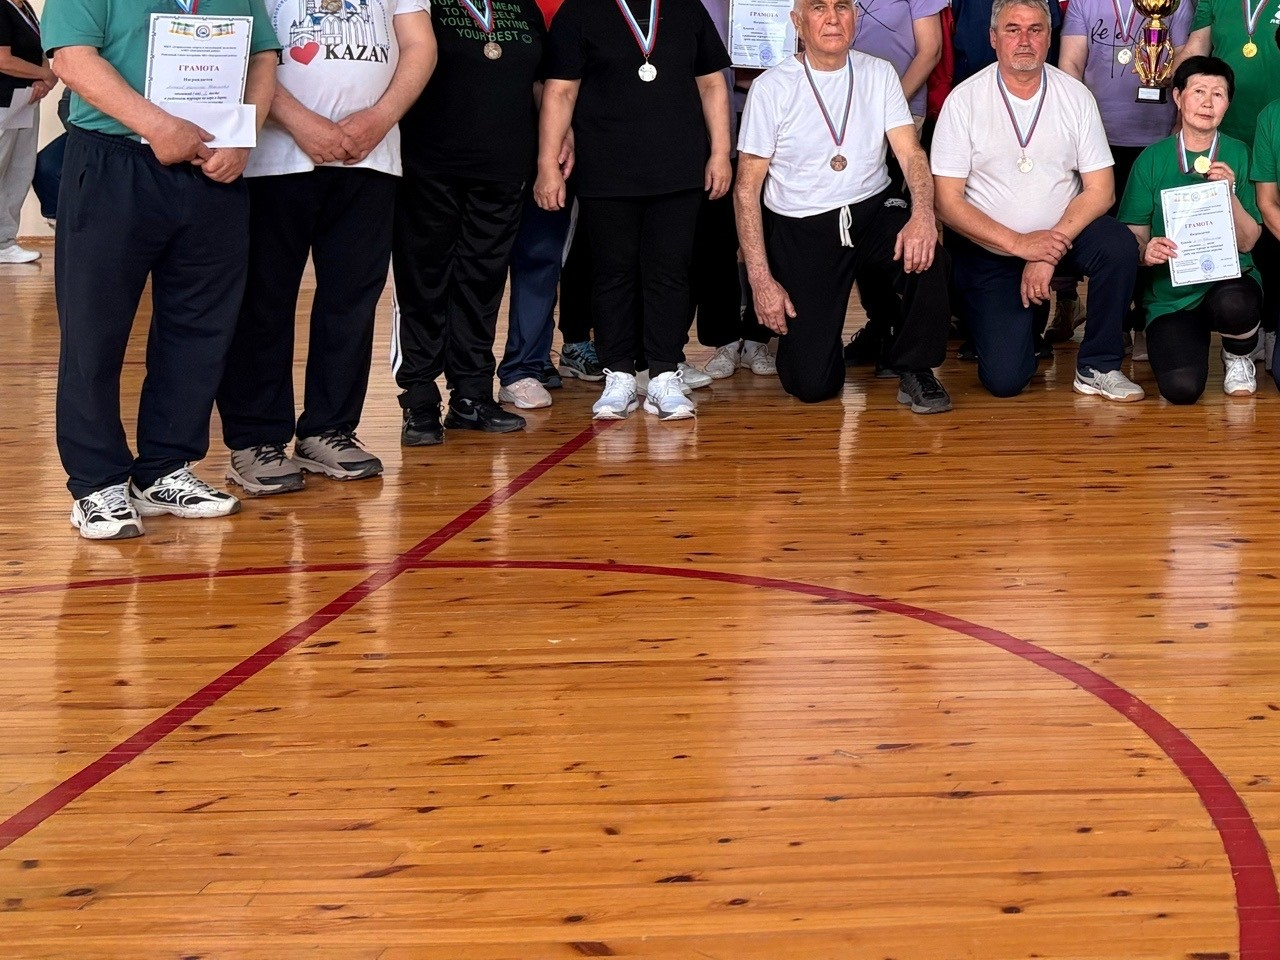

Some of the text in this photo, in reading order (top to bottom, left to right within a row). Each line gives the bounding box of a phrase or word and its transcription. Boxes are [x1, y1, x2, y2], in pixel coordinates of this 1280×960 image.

[443, 7, 459, 16] TO
[492, 1, 522, 13] MEAN
[456, 28, 518, 42] YOUR BEST
[324, 43, 390, 64] KAZAN
[1185, 221, 1214, 229] ГРАМОТА
